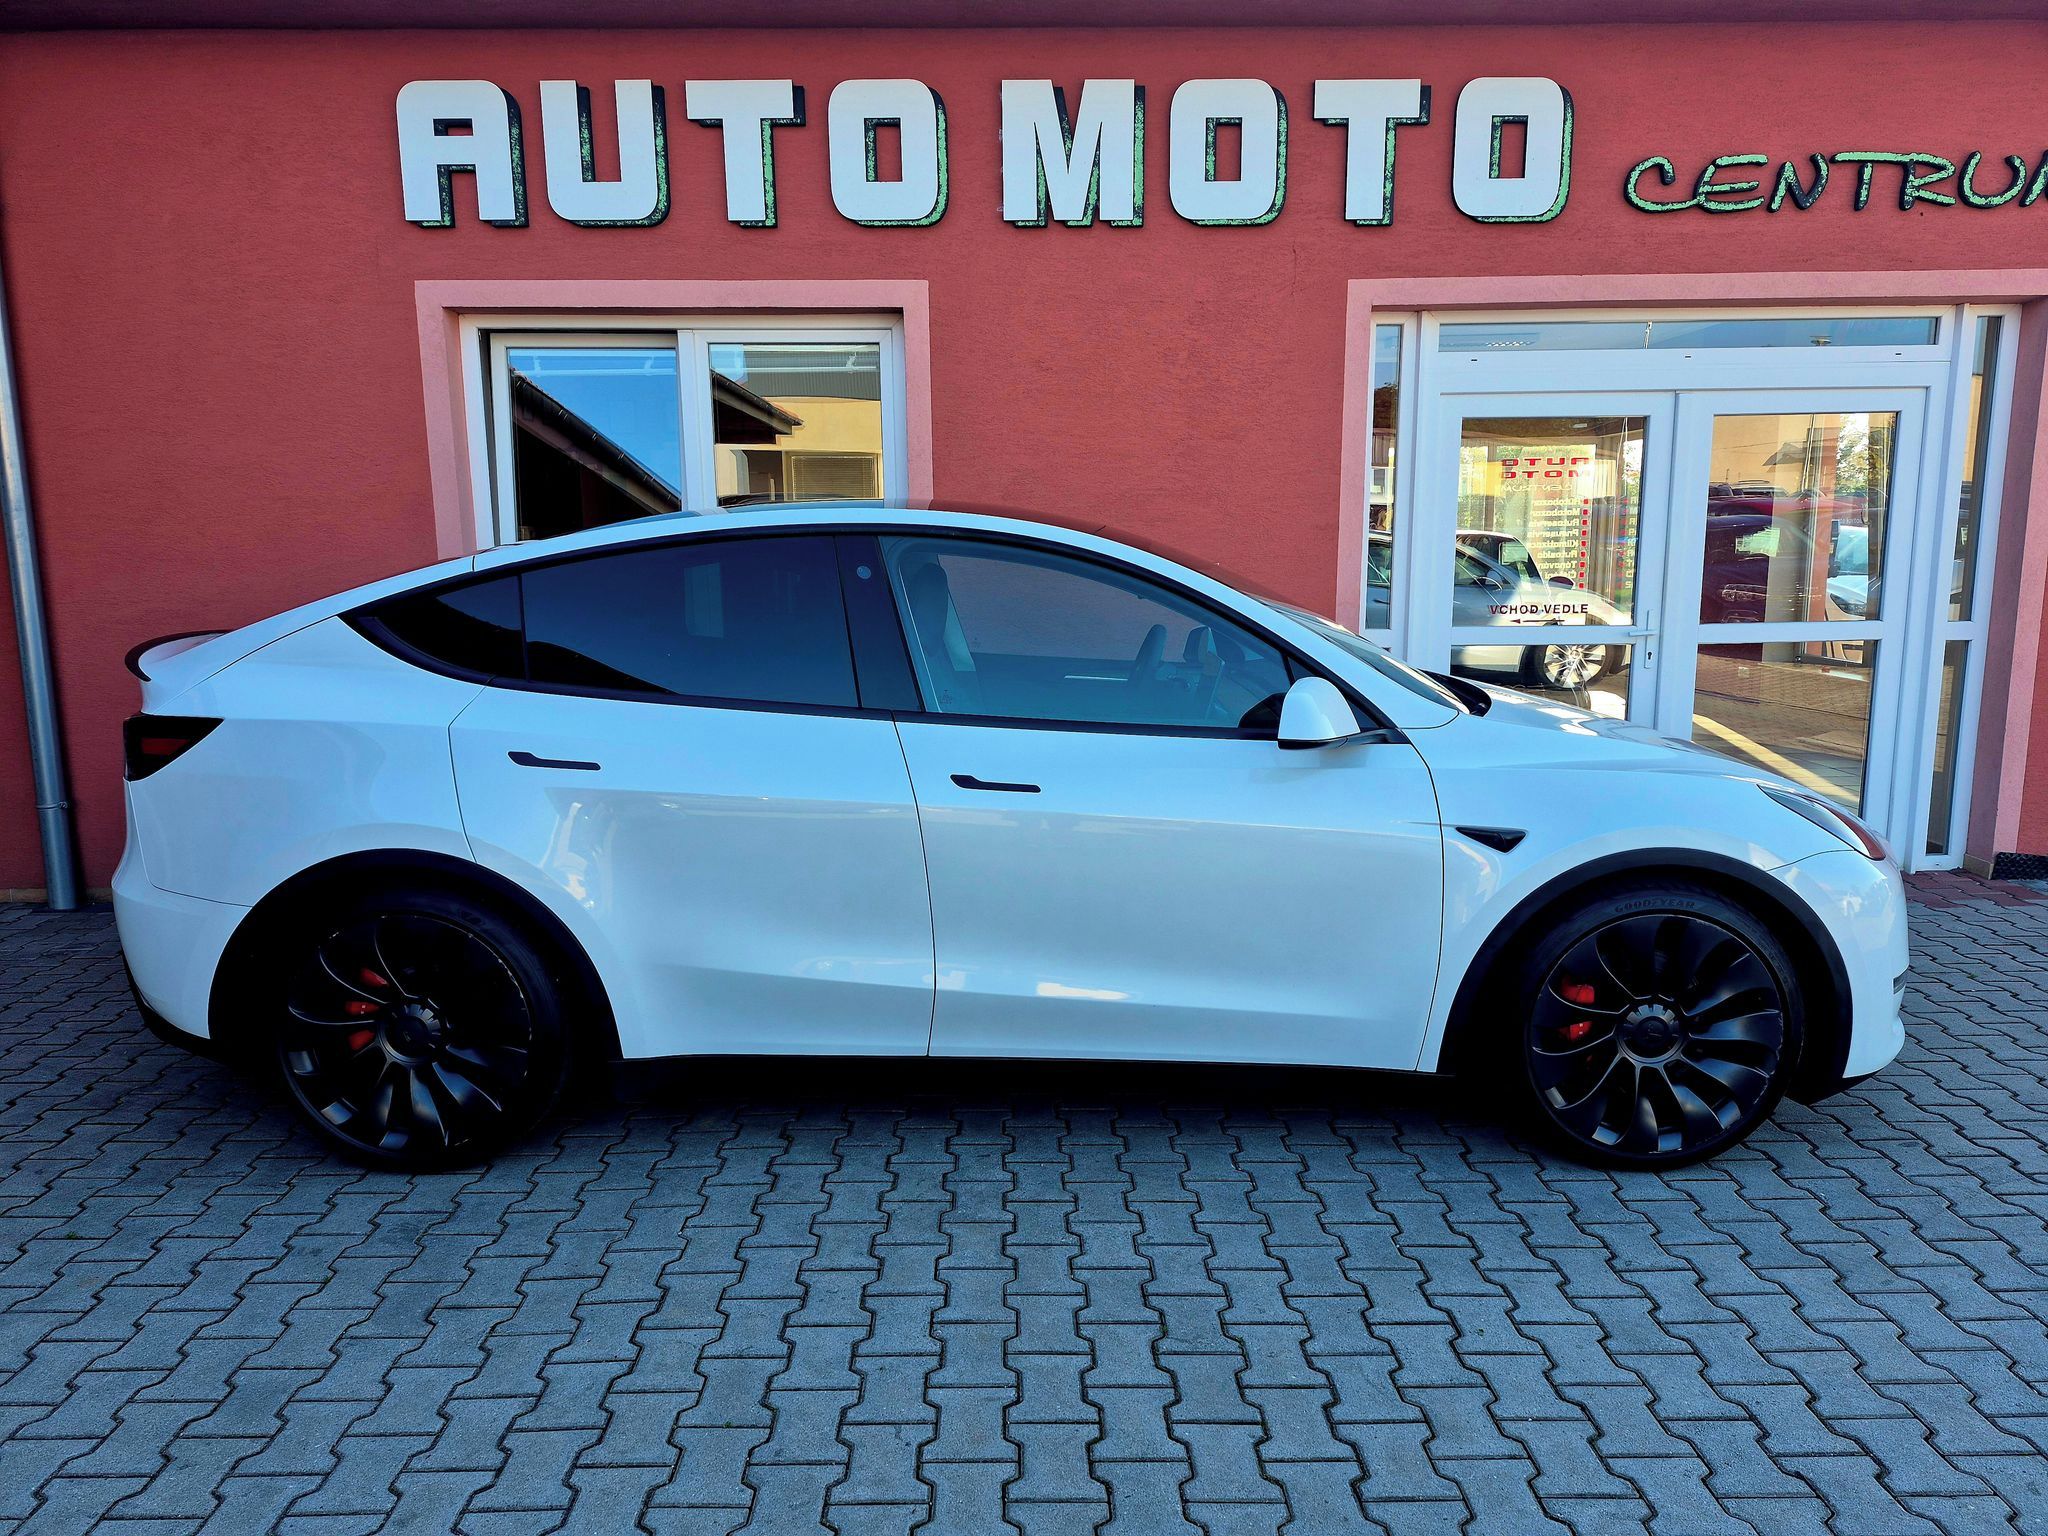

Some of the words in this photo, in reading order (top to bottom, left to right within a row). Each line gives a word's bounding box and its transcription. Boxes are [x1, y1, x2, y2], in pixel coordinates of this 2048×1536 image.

[396, 79, 947, 227] AUTO
[1000, 77, 1574, 227] MOTO
[1489, 604, 1538, 614] VCHOD
[1544, 604, 1589, 614] VEDLE
[1614, 896, 1697, 912] GOODYEAR
